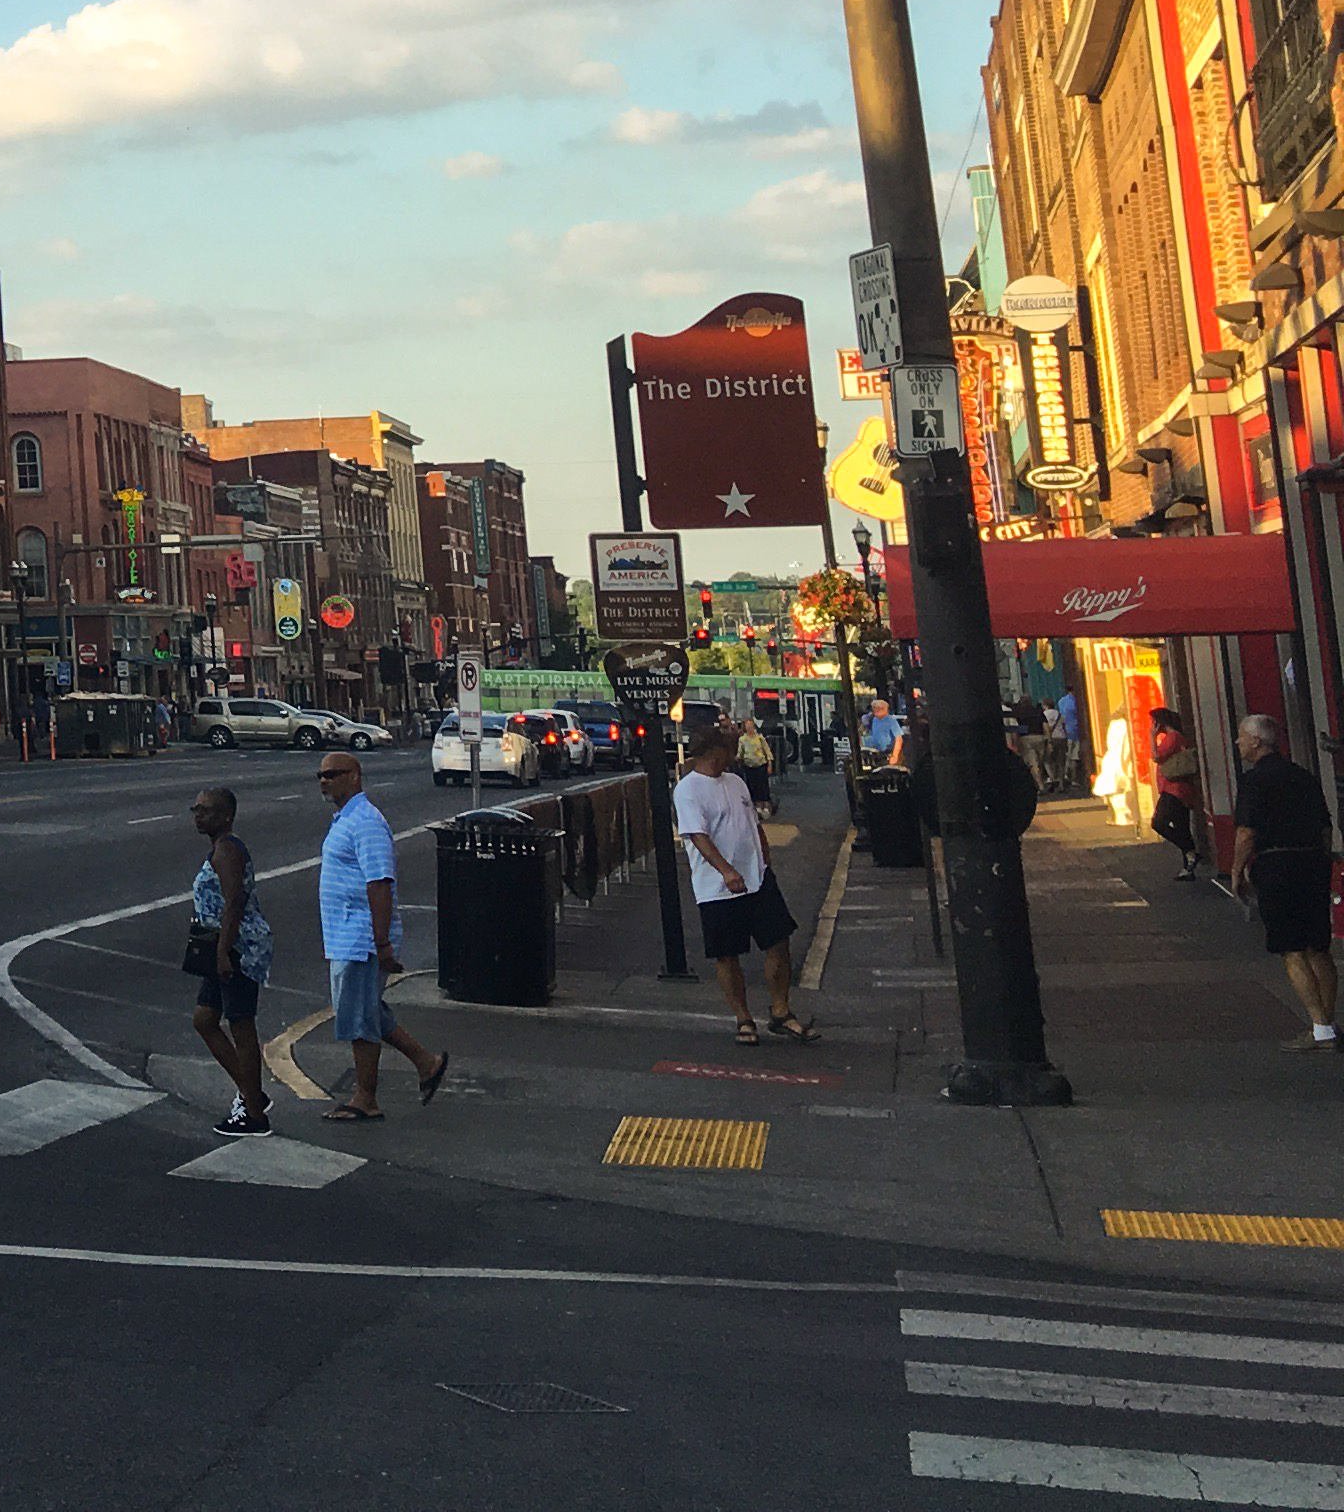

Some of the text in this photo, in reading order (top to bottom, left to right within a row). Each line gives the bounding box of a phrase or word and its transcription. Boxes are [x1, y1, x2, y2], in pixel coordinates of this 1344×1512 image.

[854, 251, 890, 280] DIAGONAL
[858, 275, 892, 304] CROSSING
[858, 311, 880, 356] OK
[906, 368, 944, 383] CROSS
[643, 371, 808, 401] The District
[910, 382, 941, 396] ONLY
[918, 395, 935, 409] ON
[605, 540, 669, 558] PRESERVE
[608, 571, 670, 581] AMERICA
[608, 596, 672, 604] WELCOME TO
[1055, 576, 1147, 615] Rippy's
[602, 605, 681, 619] THE DISTRICT
[1098, 644, 1137, 671] ATM
[483, 673, 604, 689] BART DURHAM
[616, 675, 683, 686] LIVE MUSIC
[624, 690, 671, 700] VENUES
